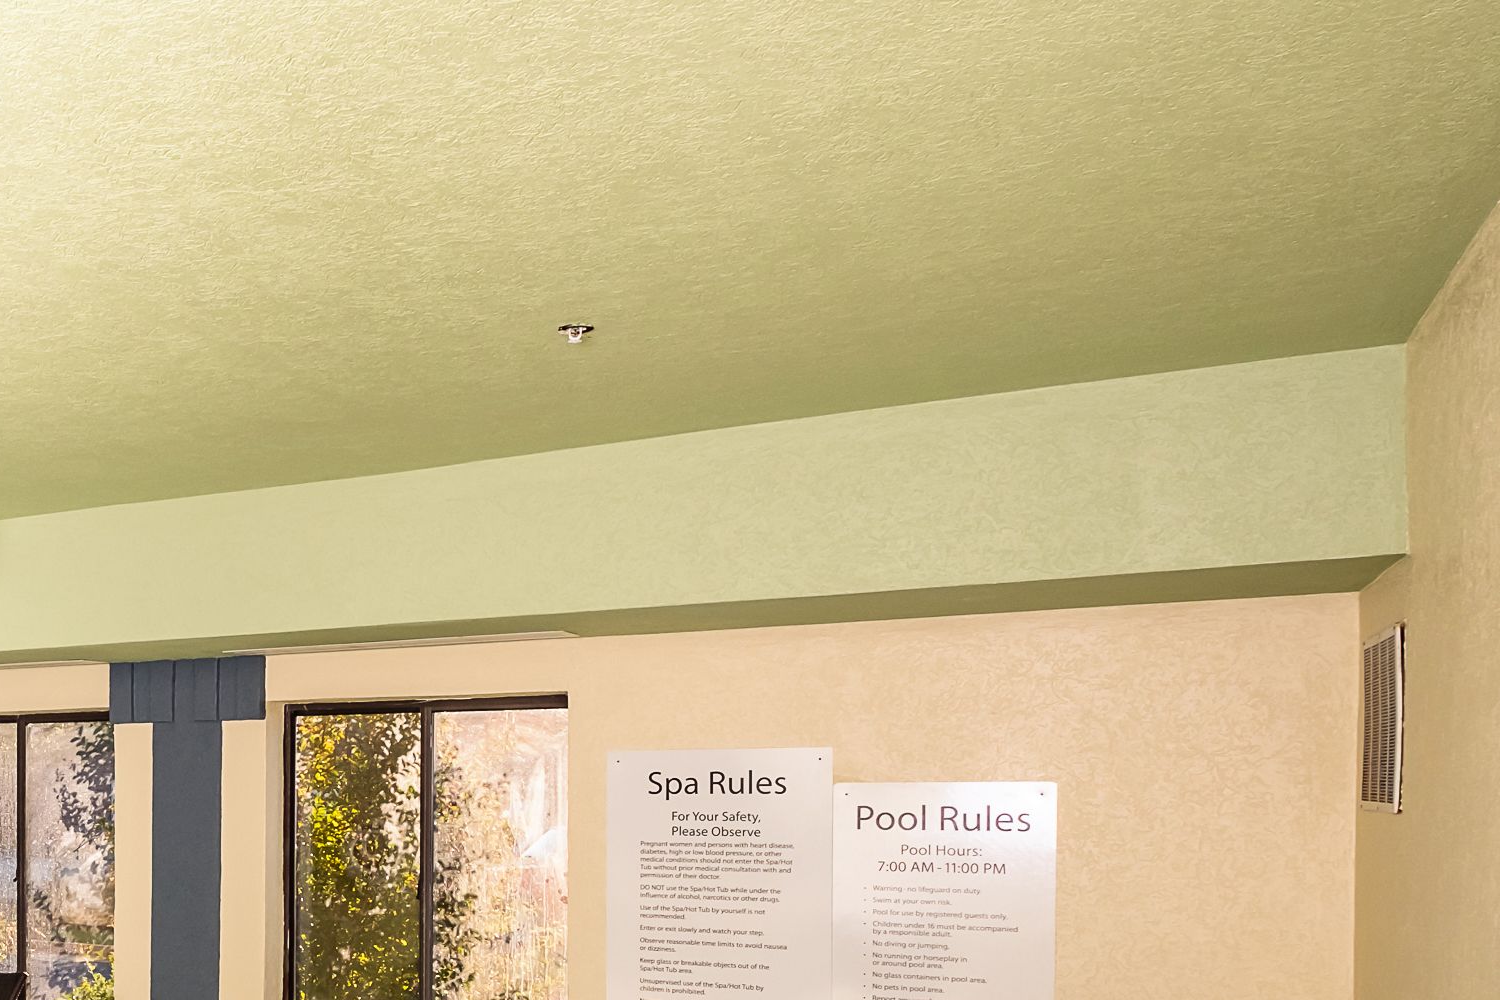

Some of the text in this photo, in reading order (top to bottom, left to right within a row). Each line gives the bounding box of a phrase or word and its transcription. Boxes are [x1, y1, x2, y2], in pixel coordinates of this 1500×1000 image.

[648, 769, 787, 800] Spa Rules
[671, 811, 761, 824] For Your Safety,
[856, 804, 1031, 832] Pool Rules
[671, 826, 761, 838] Please Observe
[900, 844, 983, 857] Pool Hours:
[878, 861, 907, 873] 7:00
[911, 861, 934, 873] AM
[945, 862, 980, 874] 11:00
[983, 863, 1006, 875] PM
